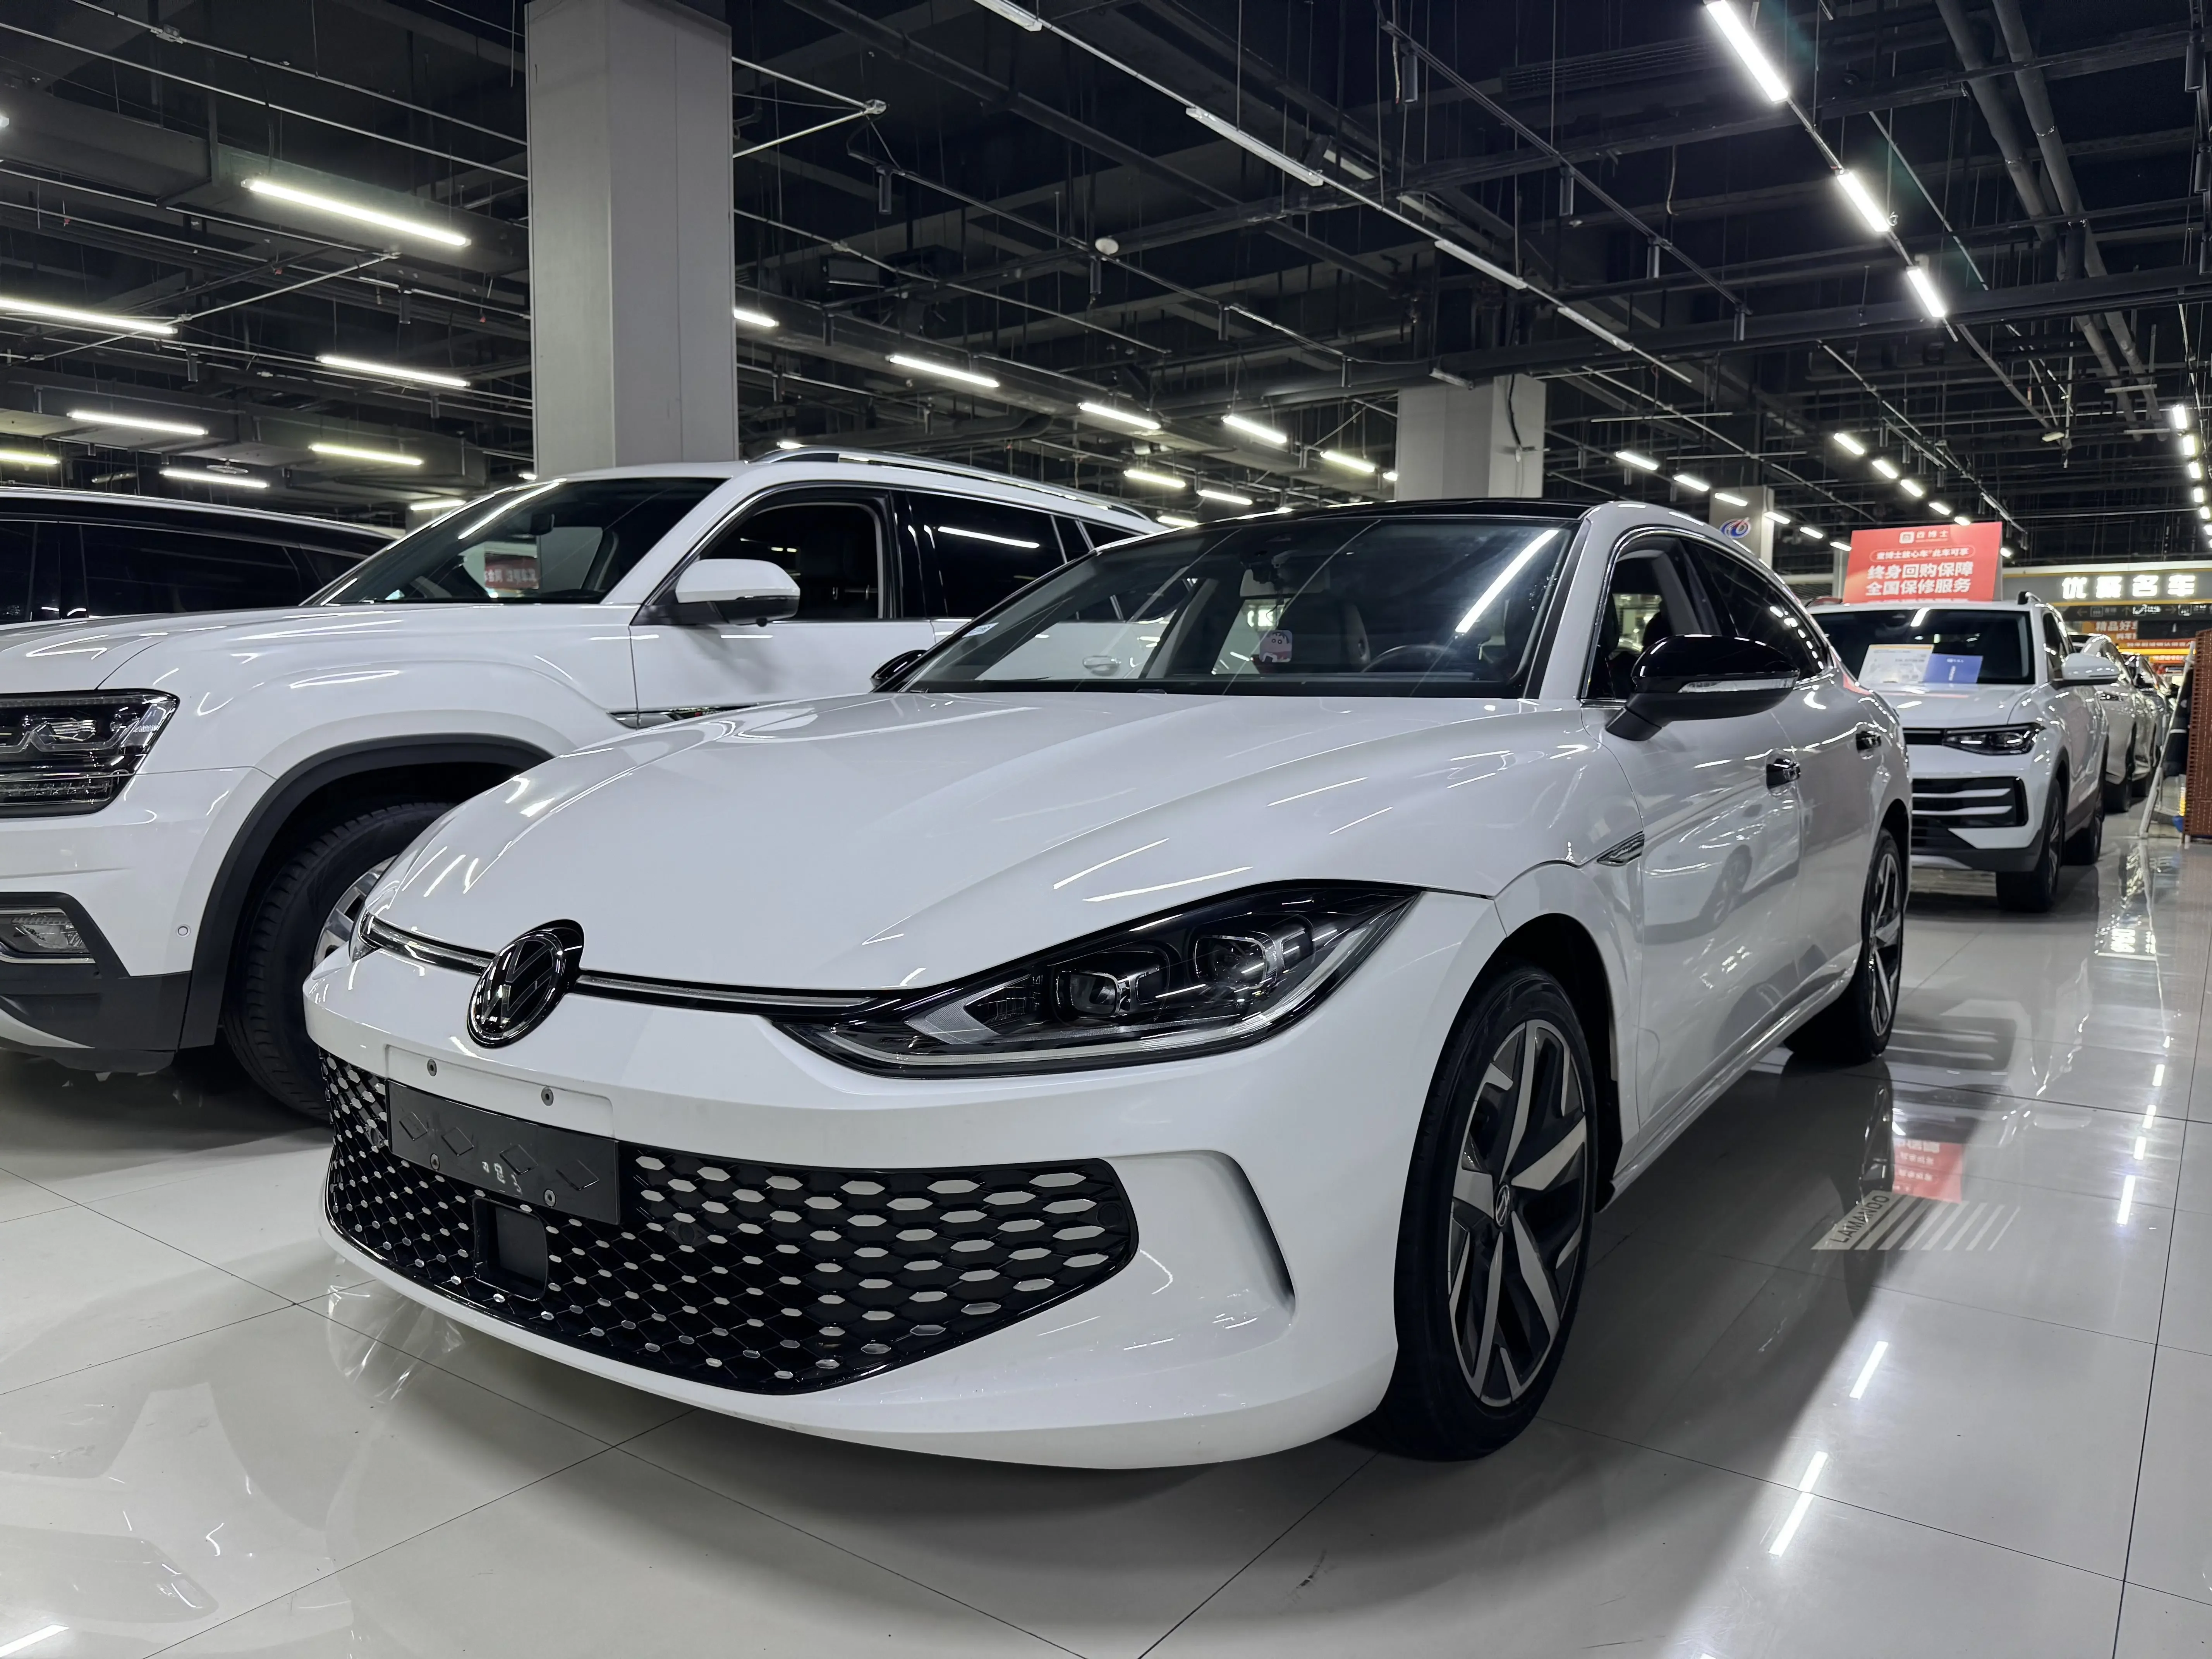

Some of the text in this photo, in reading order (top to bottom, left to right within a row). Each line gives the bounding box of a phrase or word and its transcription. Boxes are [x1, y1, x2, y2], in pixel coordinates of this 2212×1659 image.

[1867, 562, 1973, 579] 终身回购保障
[1866, 578, 1971, 596] 全国保修服务
[1829, 1195, 1890, 1243] LAMANDO
